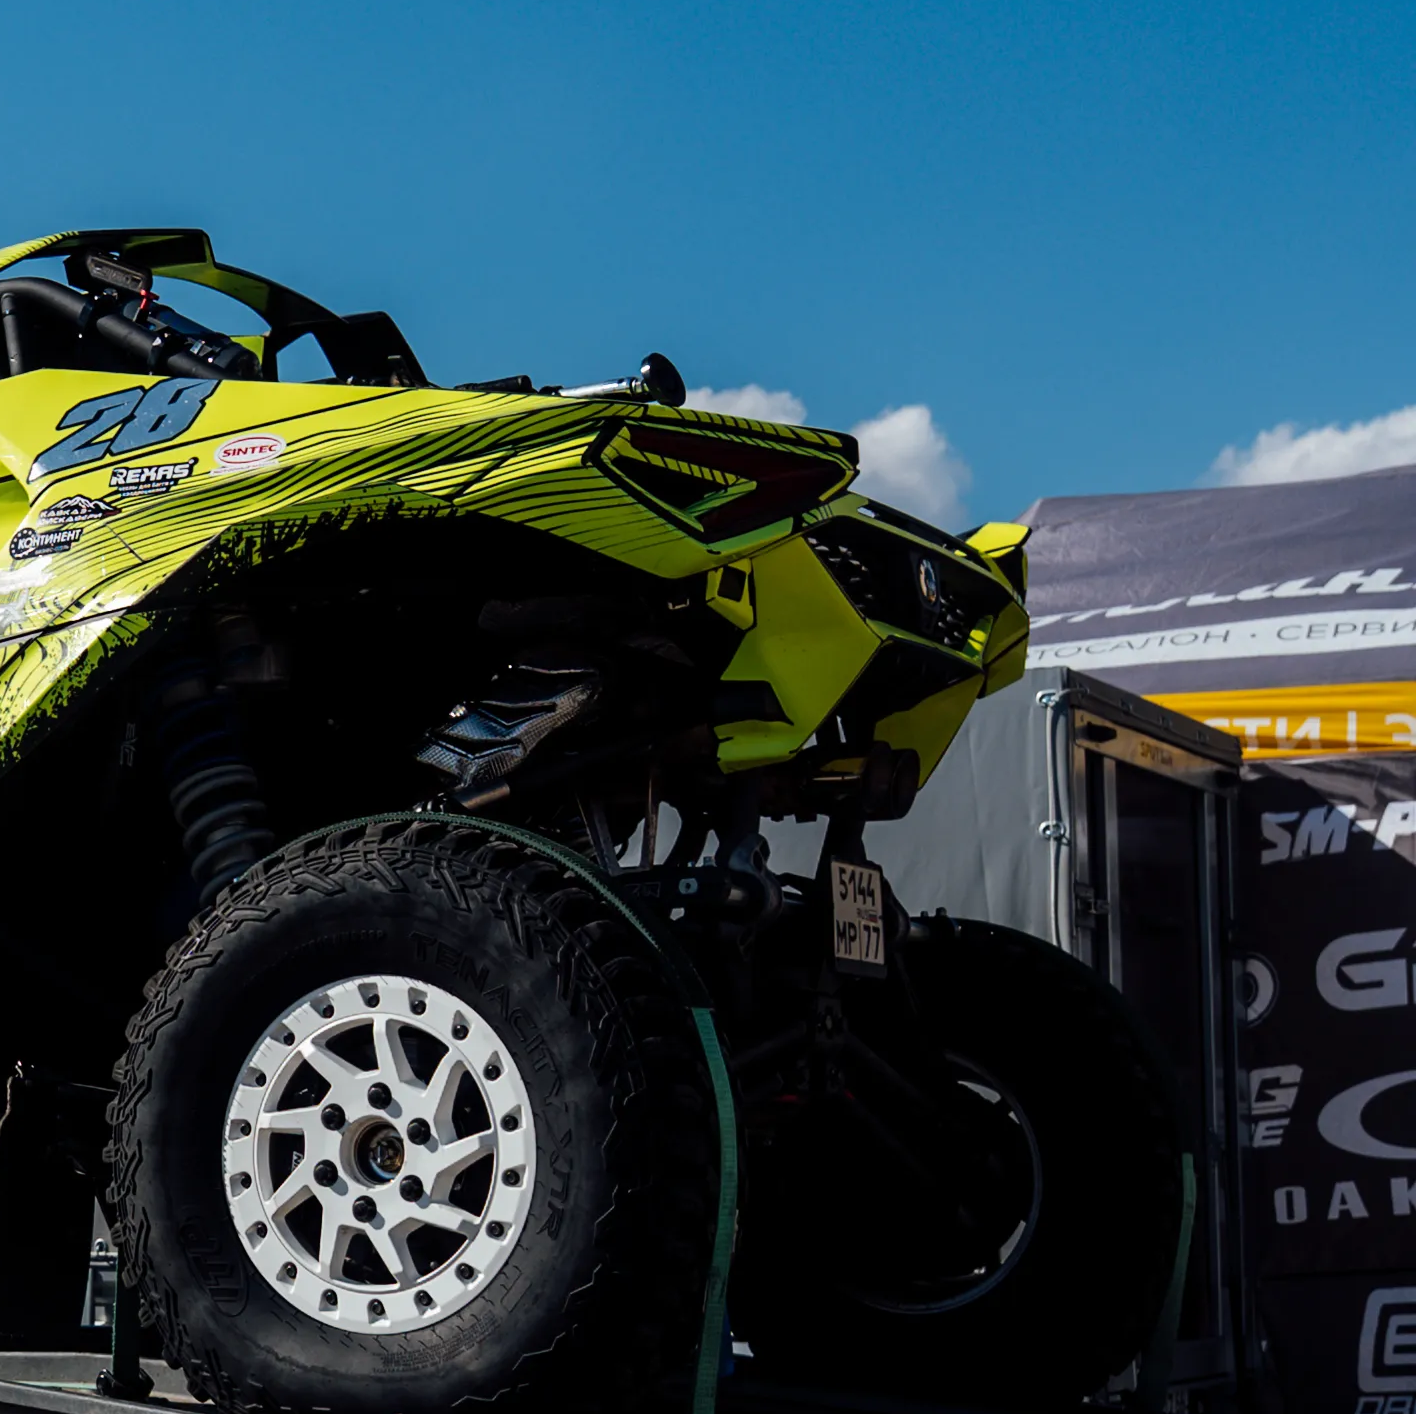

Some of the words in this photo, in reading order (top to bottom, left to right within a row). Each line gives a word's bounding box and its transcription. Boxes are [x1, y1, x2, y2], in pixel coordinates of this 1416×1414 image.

[27, 377, 223, 483] 28
[222, 444, 278, 457] SINTEC
[109, 463, 191, 486] REXAS
[18, 529, 82, 550] КОНТИНЕНТ
[1027, 629, 1230, 661] ТОСАЛОН
[839, 867, 875, 906] 5144
[862, 923, 881, 959] 77
[1248, 1063, 1304, 1116] G
[1251, 1116, 1292, 1149] E
